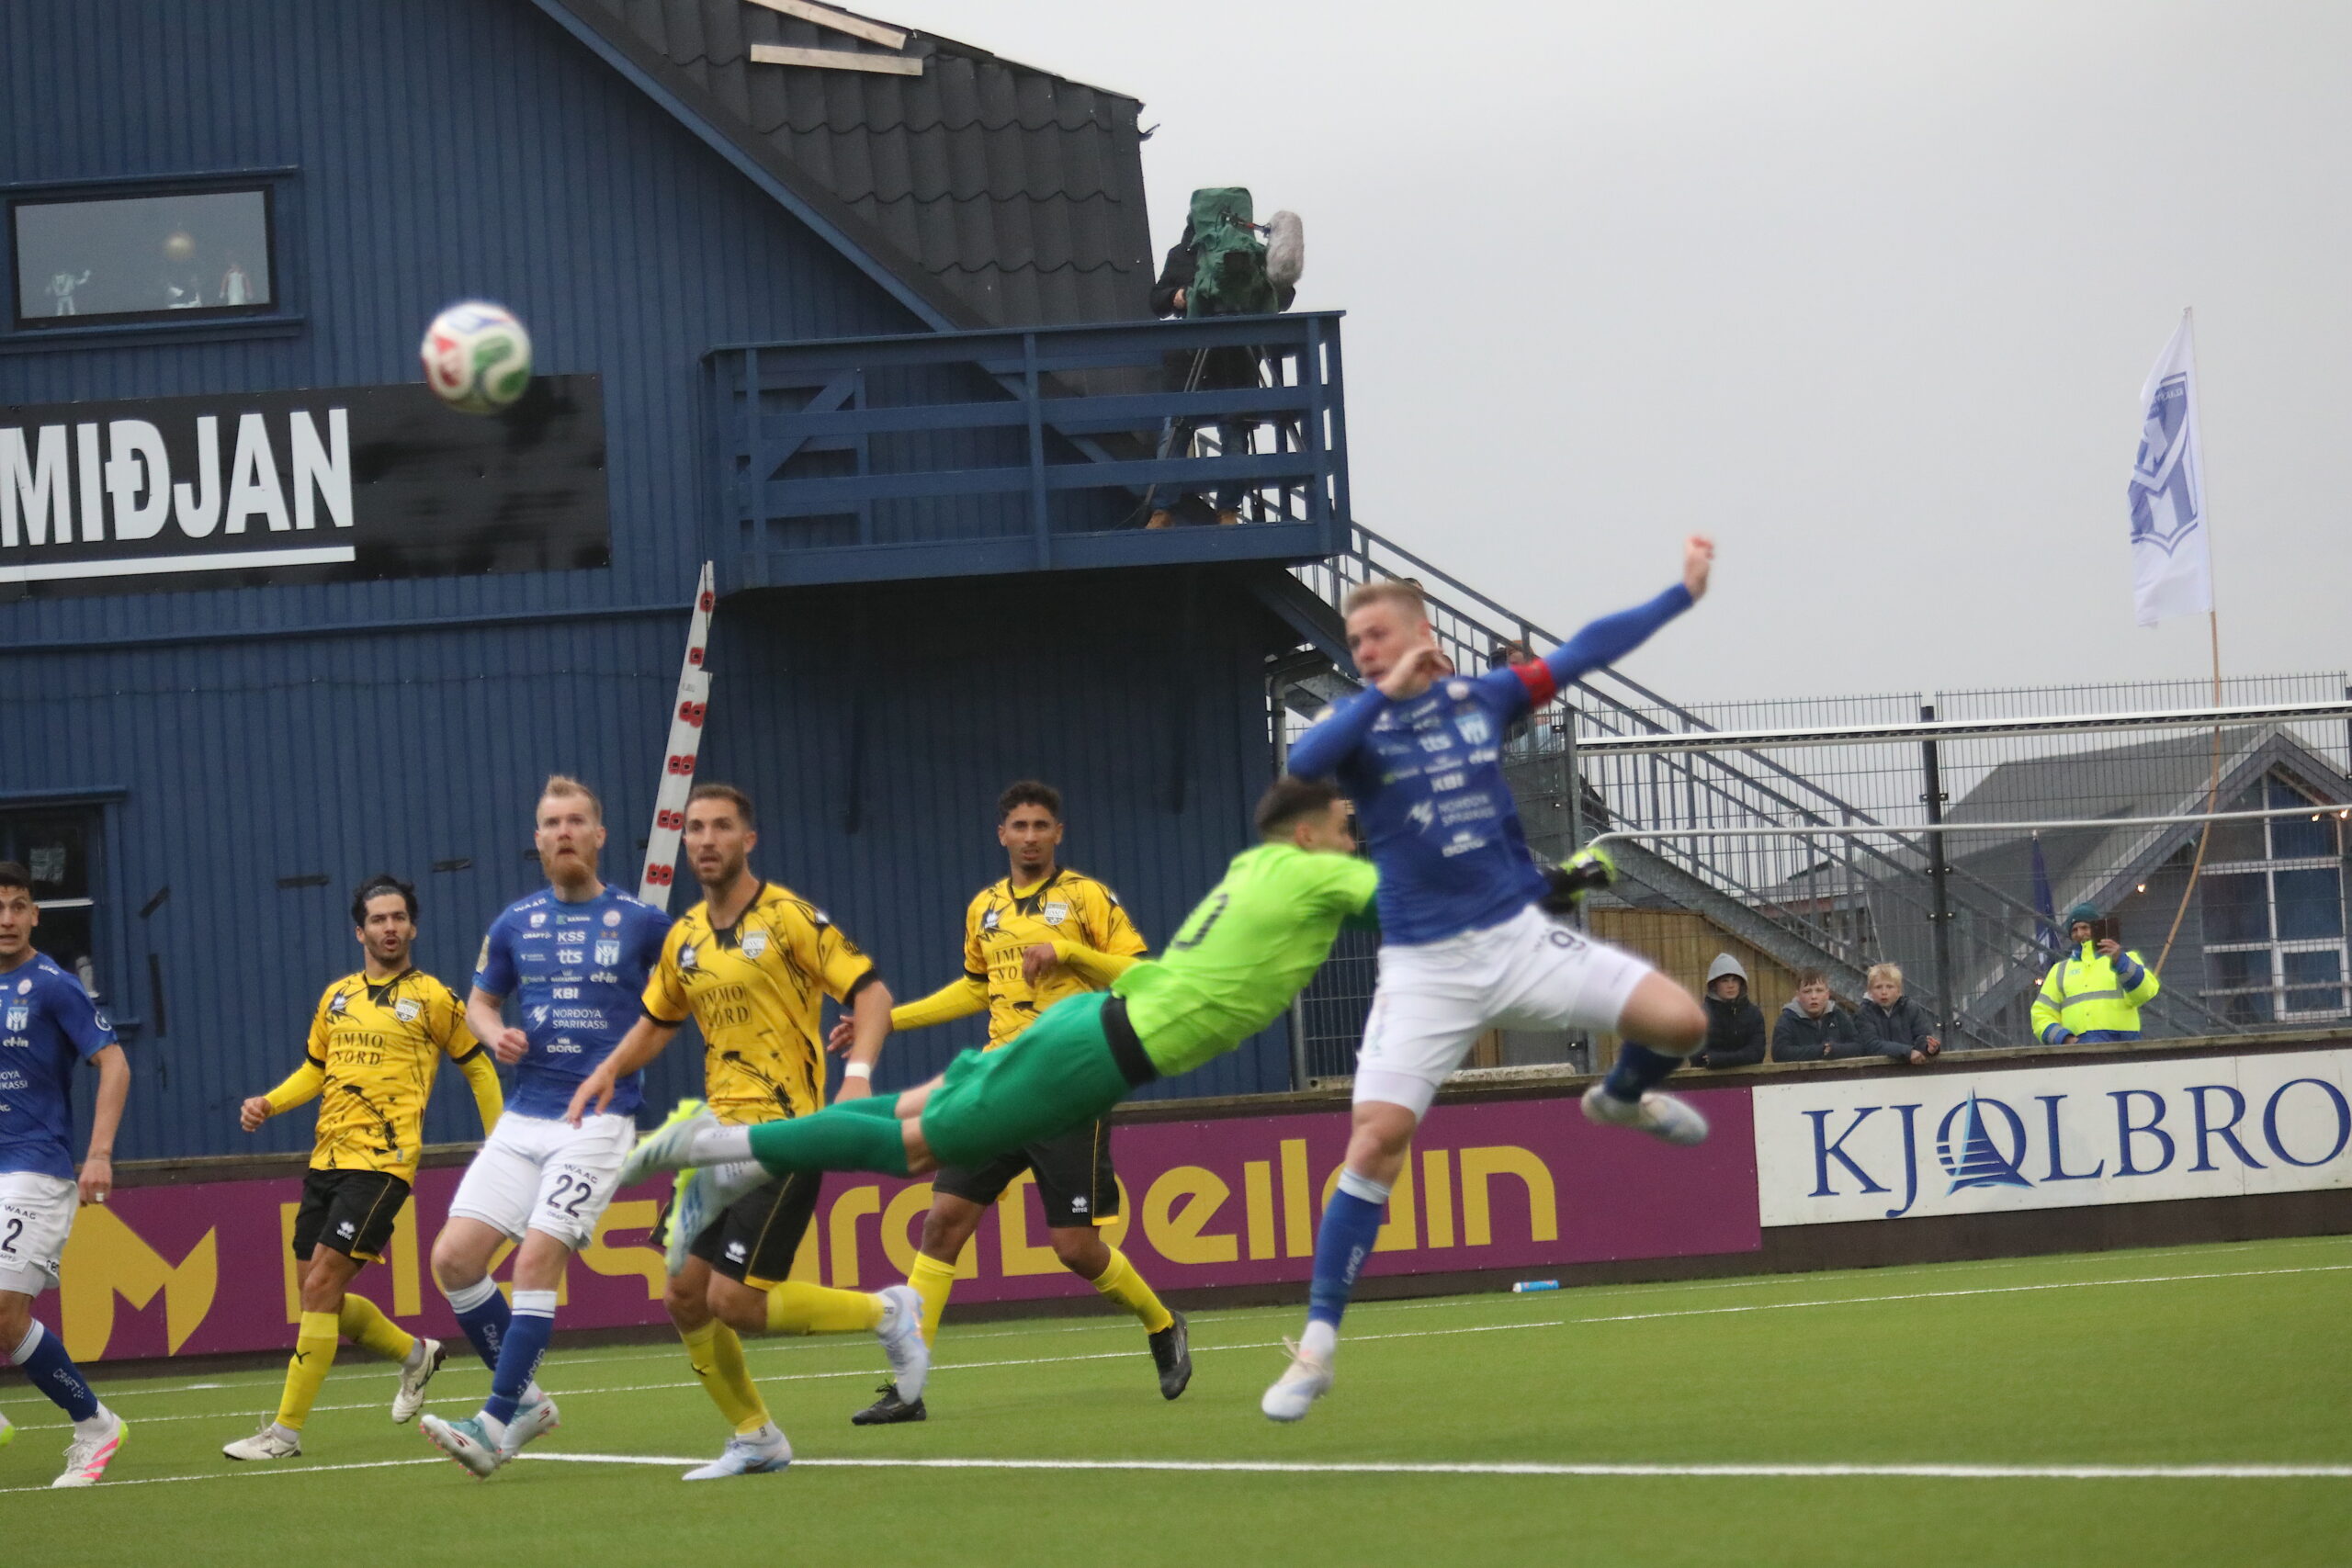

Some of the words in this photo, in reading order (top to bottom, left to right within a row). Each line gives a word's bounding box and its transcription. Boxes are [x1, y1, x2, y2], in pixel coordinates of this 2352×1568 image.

[0, 409, 355, 547] MIÐJAN
[557, 931, 585, 942] KSS
[556, 949, 583, 964] tts
[553, 987, 579, 999] KBI
[552, 1020, 608, 1030] SPARIKASSI
[337, 1032, 383, 1048] IMMO
[547, 1174, 592, 1219] 22
[483, 1323, 503, 1359] CRAF
